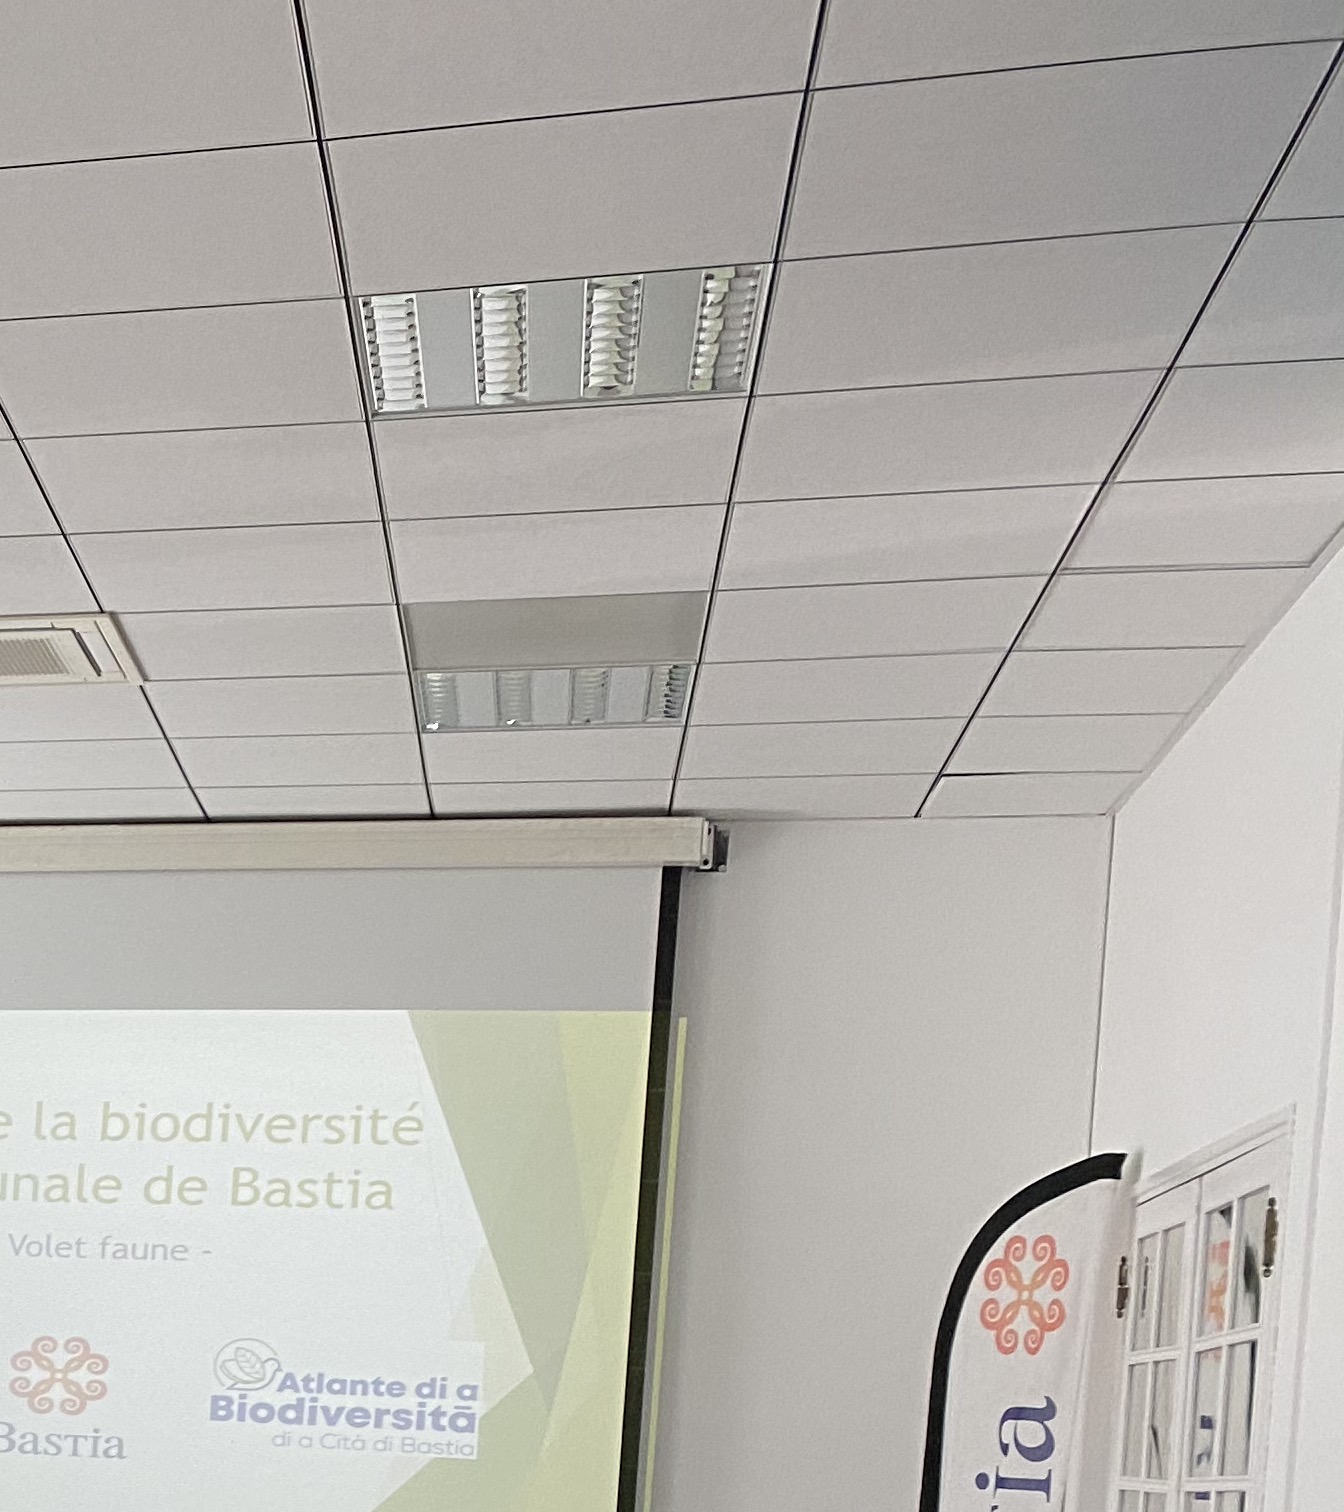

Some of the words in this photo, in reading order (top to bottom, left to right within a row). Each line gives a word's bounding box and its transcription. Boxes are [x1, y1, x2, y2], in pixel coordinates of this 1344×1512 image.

[34, 1100, 78, 1142] la
[99, 1100, 425, 1146] biodiversité
[143, 1164, 209, 1206] de
[230, 1166, 394, 1211] Bastia
[7, 1232, 87, 1259] Volet
[99, 1235, 190, 1261] faune
[276, 1371, 407, 1398] Atlante
[414, 1376, 448, 1400] di
[455, 1383, 480, 1401] a
[271, 1430, 292, 1448] di
[297, 1436, 313, 1449] a
[372, 1435, 393, 1453] di
[401, 1436, 474, 1457] Bastia
